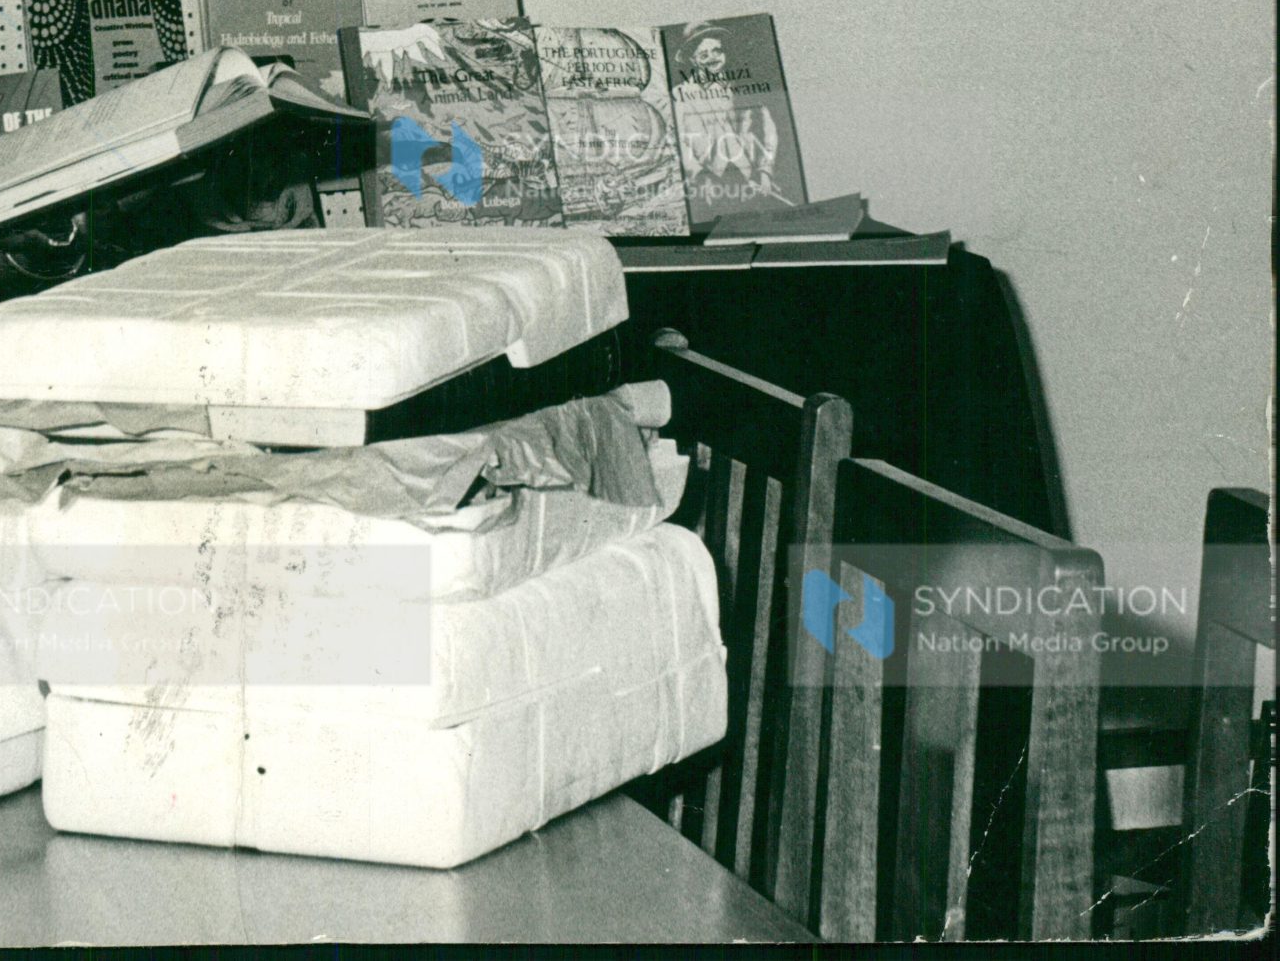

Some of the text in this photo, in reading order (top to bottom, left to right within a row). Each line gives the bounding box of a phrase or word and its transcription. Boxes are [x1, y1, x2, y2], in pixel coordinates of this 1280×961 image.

[543, 47, 657, 61] THE PORTUGUESE
[567, 61, 613, 74] PERIOD
[421, 67, 495, 84] The Great
[562, 75, 646, 89] EAST AFRICA
[422, 89, 513, 104] Animal Land
